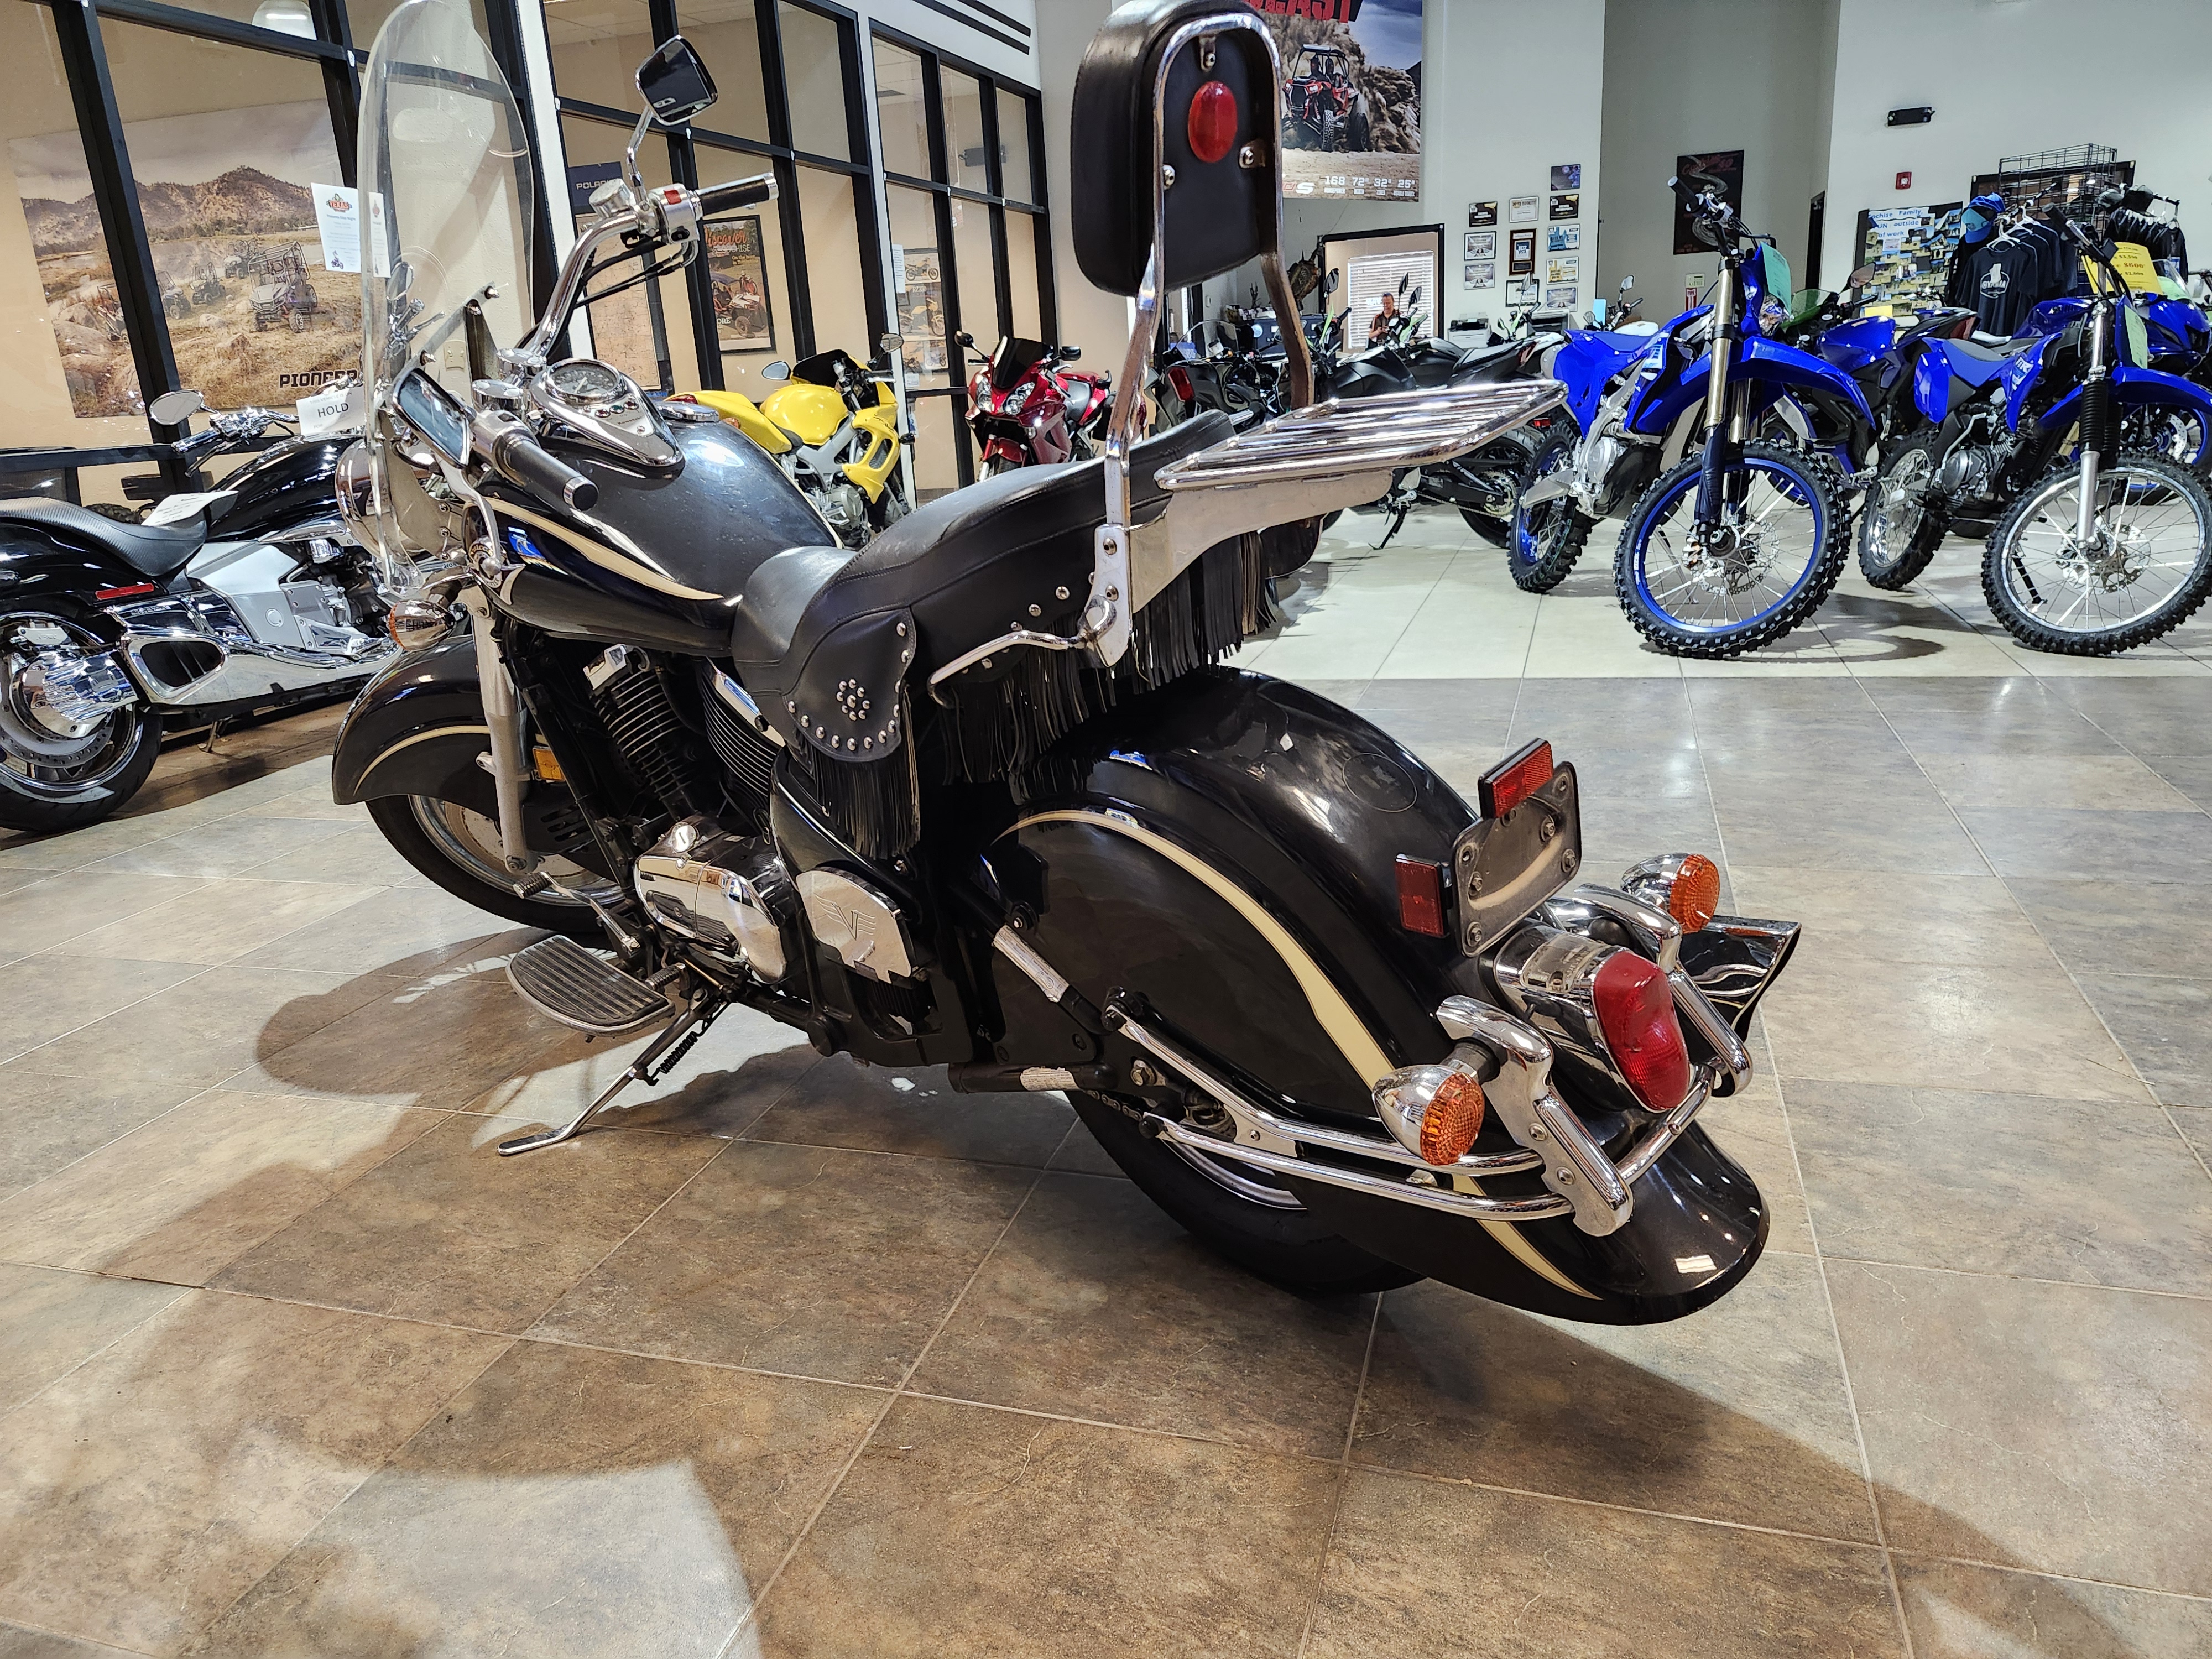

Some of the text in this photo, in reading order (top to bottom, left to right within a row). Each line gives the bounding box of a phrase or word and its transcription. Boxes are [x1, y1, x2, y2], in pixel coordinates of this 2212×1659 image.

[1325, 176, 1345, 185] 168
[1352, 177, 1369, 186] 72"
[1397, 179, 1415, 188] 25"
[329, 200, 349, 210] TEXAS
[317, 403, 349, 418] HOLD
